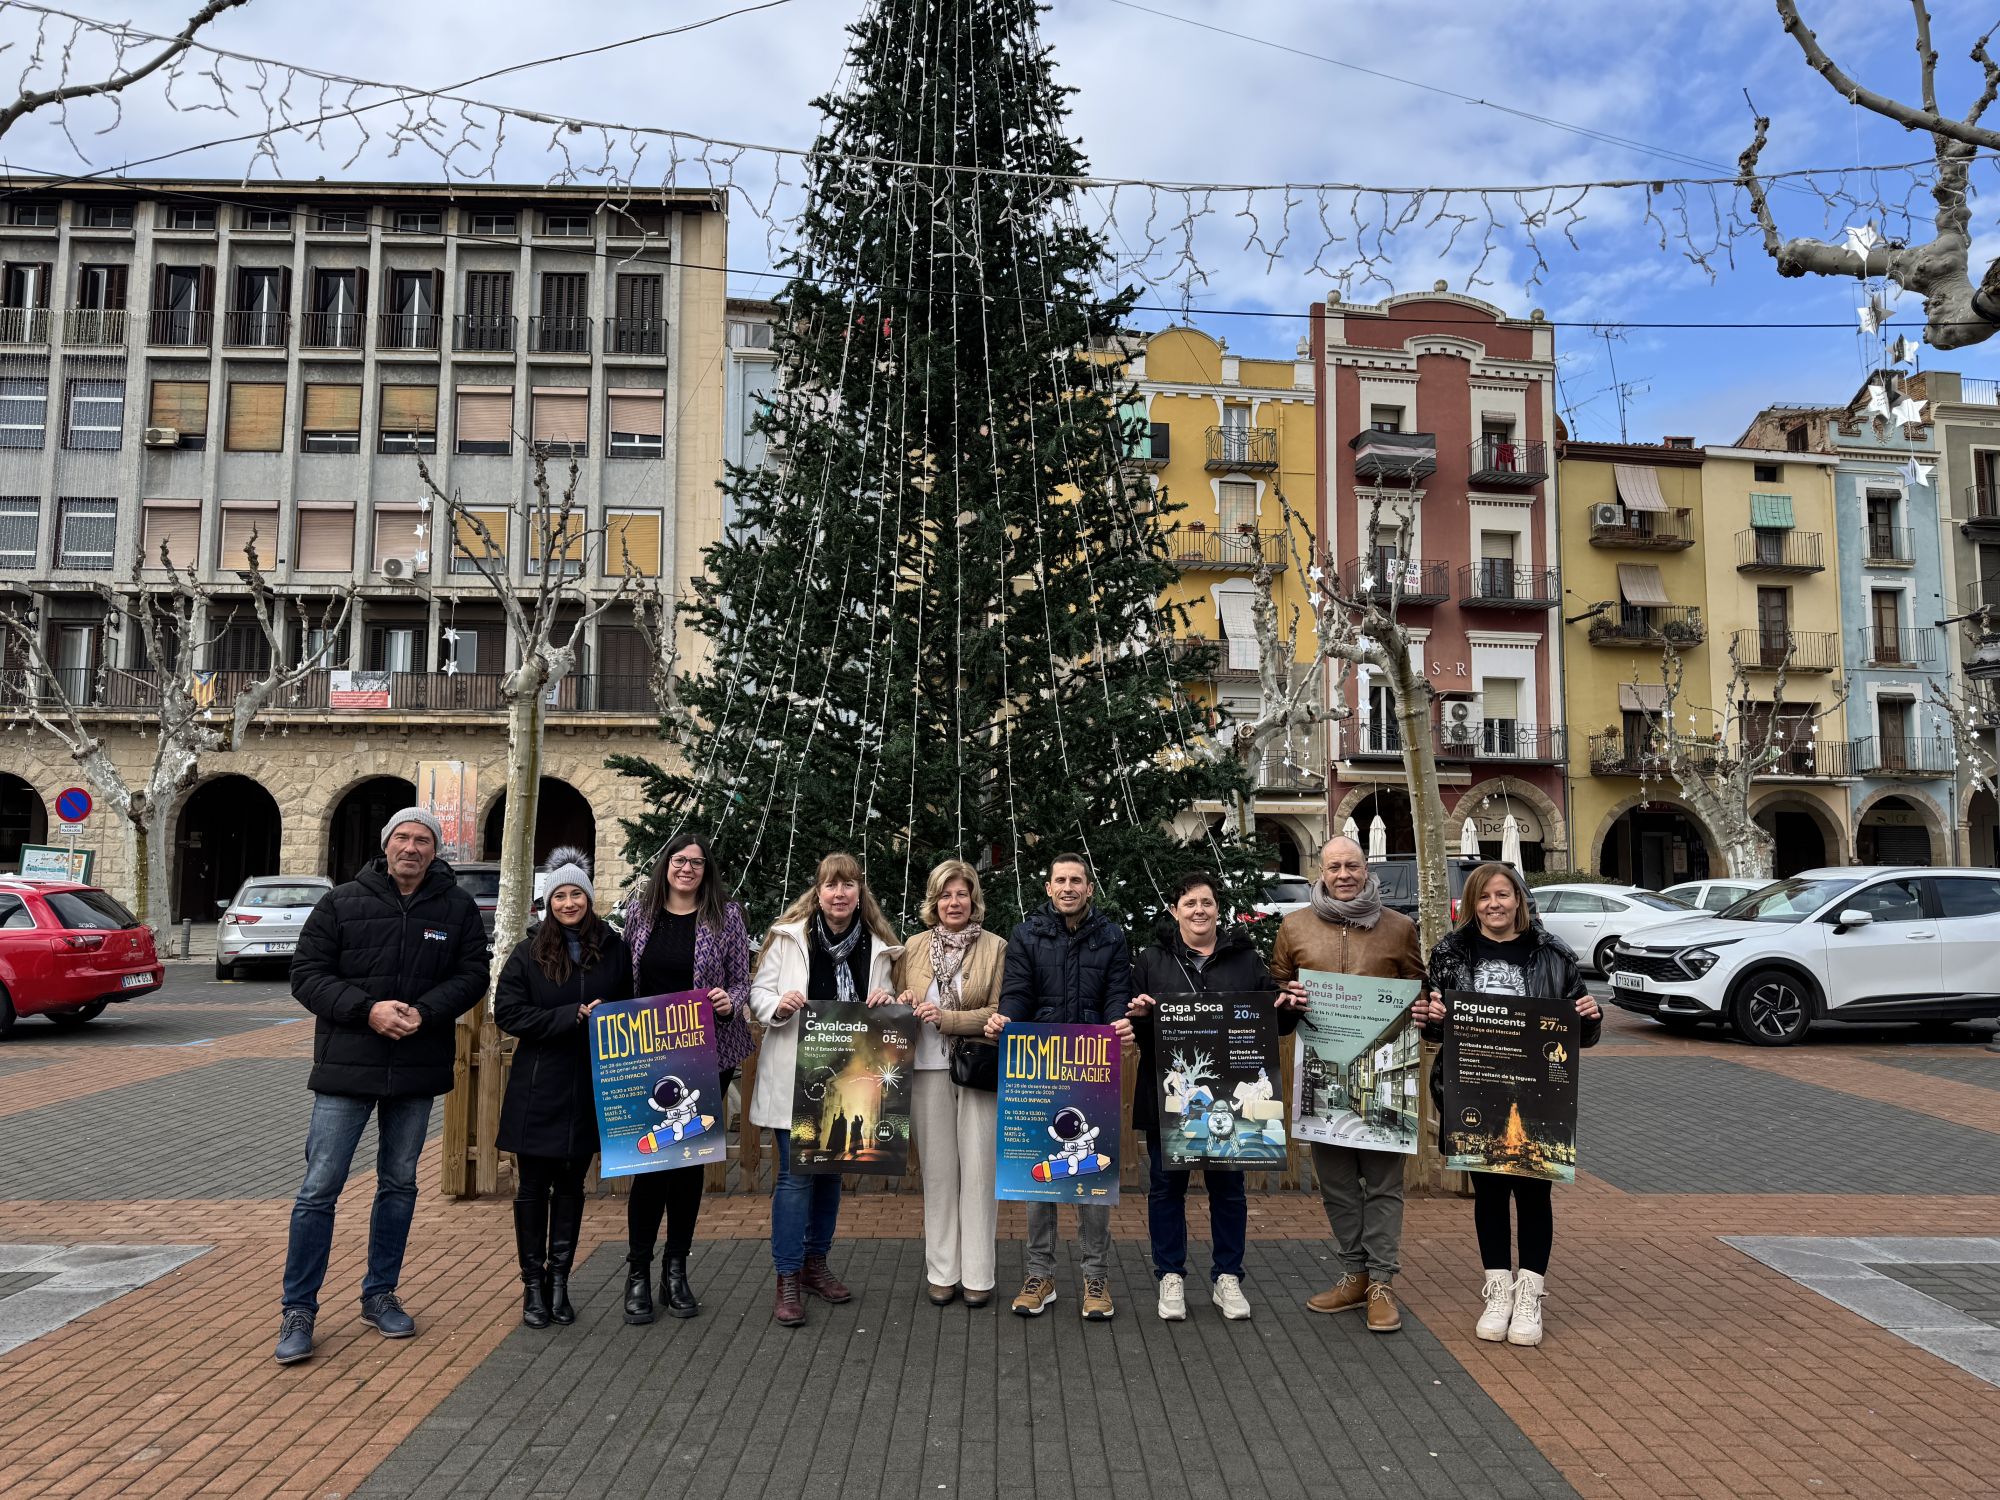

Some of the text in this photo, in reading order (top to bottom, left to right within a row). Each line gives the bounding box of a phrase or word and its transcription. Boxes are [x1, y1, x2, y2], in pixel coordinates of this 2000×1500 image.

[1432, 661, 1467, 676] S R
[1305, 979, 1344, 991] On és la
[1307, 989, 1363, 1002] meua pipa?
[806, 1010, 817, 1018] La
[1159, 1002, 1224, 1015] Caga Soca
[1453, 1000, 1508, 1015] Foguera
[1160, 1014, 1196, 1022] de Nadal
[1453, 1013, 1526, 1027] dels Innocents
[805, 1020, 868, 1032] Cavalcada
[655, 1031, 706, 1052] BALAGUER
[804, 1032, 853, 1043] de Reixos
[1061, 1066, 1111, 1083] BALAGUER
